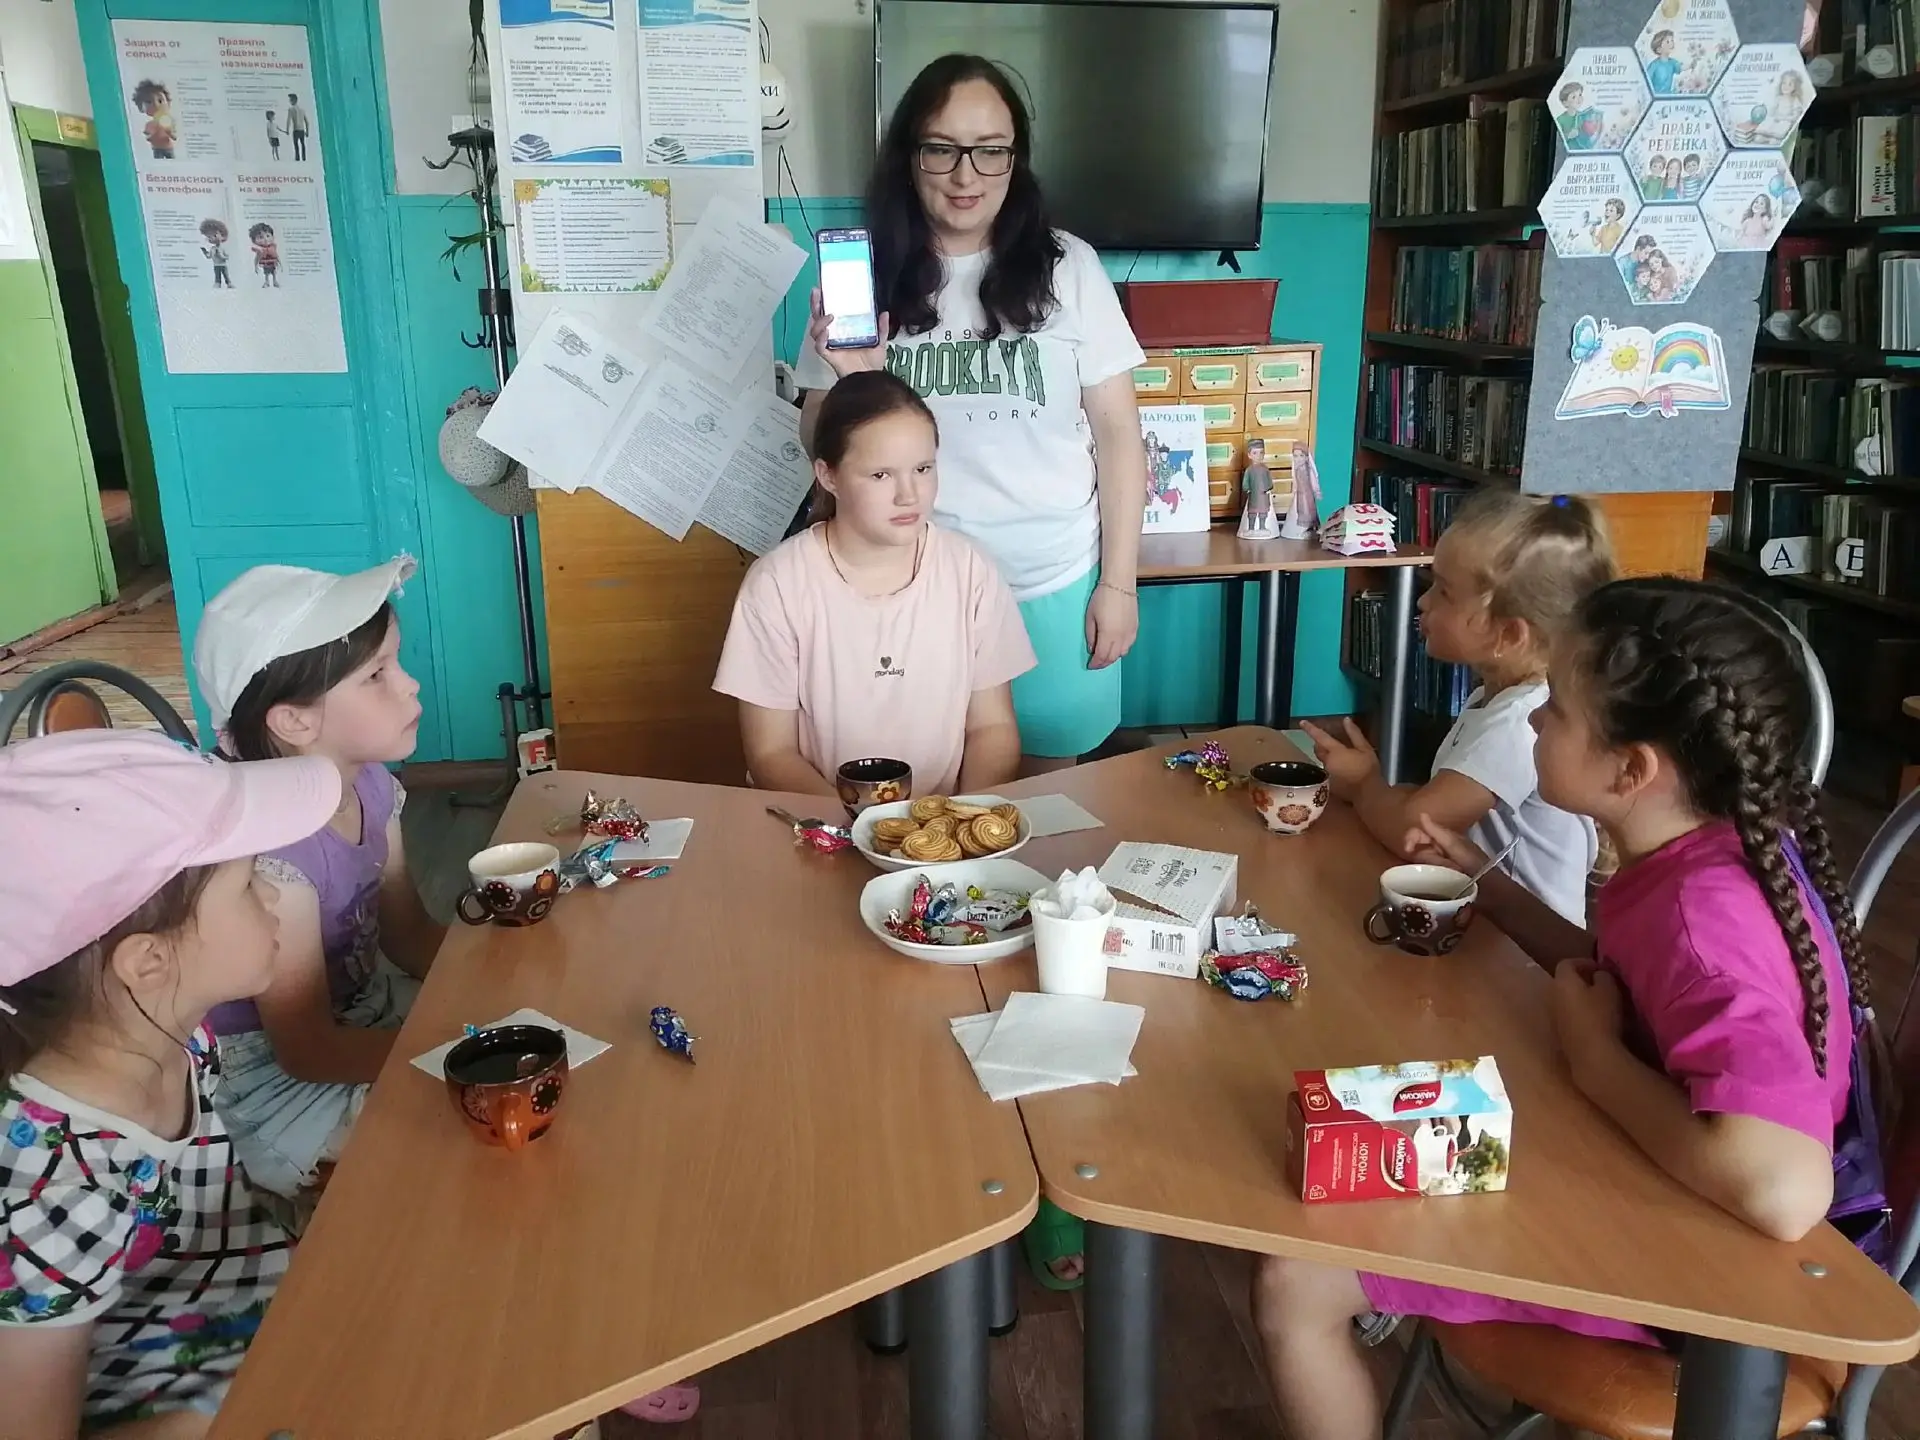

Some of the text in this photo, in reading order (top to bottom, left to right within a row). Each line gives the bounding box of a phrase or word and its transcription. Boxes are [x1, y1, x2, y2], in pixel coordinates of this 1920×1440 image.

[124, 38, 180, 48] Защита от
[218, 37, 265, 47] Правила
[125, 51, 167, 59] солнца
[1592, 54, 1618, 64] ПРАВО
[1595, 66, 1628, 76] ЗАЩИТУ
[1660, 122, 1701, 135] ПРАВА
[1572, 162, 1598, 172] ПРАВО
[145, 173, 224, 184] Безопасность
[237, 174, 314, 184] Безопасность
[1566, 174, 1616, 184] ВЫРАЖЕНИЕ
[156, 186, 213, 195] телефоне
[1559, 186, 1588, 195] СВОЕГО
[966, 408, 1040, 422] YORK
[1140, 412, 1197, 424] НАРОДОВ
[1356, 1142, 1369, 1183] КОРОНА
[1393, 1137, 1407, 1181] МАЙСКИЙ
